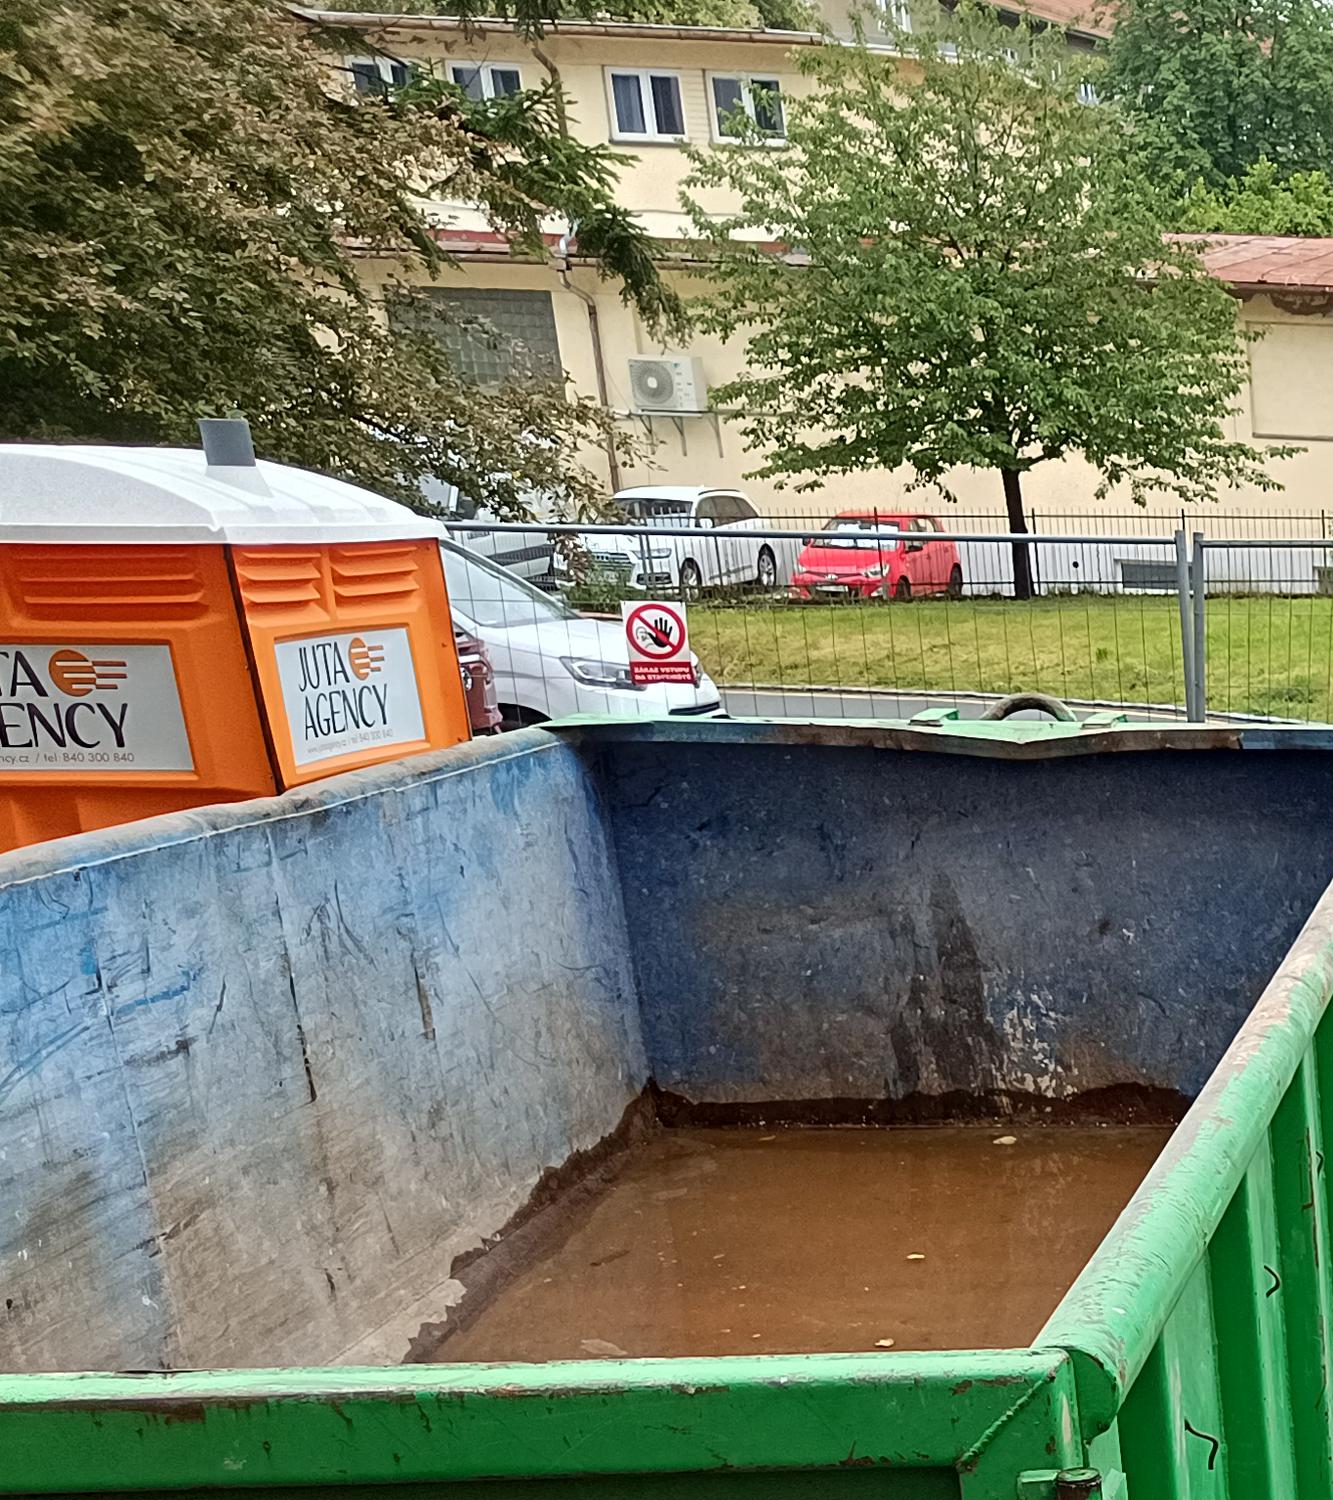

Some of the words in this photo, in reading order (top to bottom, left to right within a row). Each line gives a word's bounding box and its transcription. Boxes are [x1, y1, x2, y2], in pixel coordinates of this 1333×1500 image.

[298, 641, 350, 692] JUTA
[305, 683, 387, 741] AGENCY
[63, 752, 85, 763] 840
[88, 752, 110, 763] 300
[113, 752, 134, 763] 840
